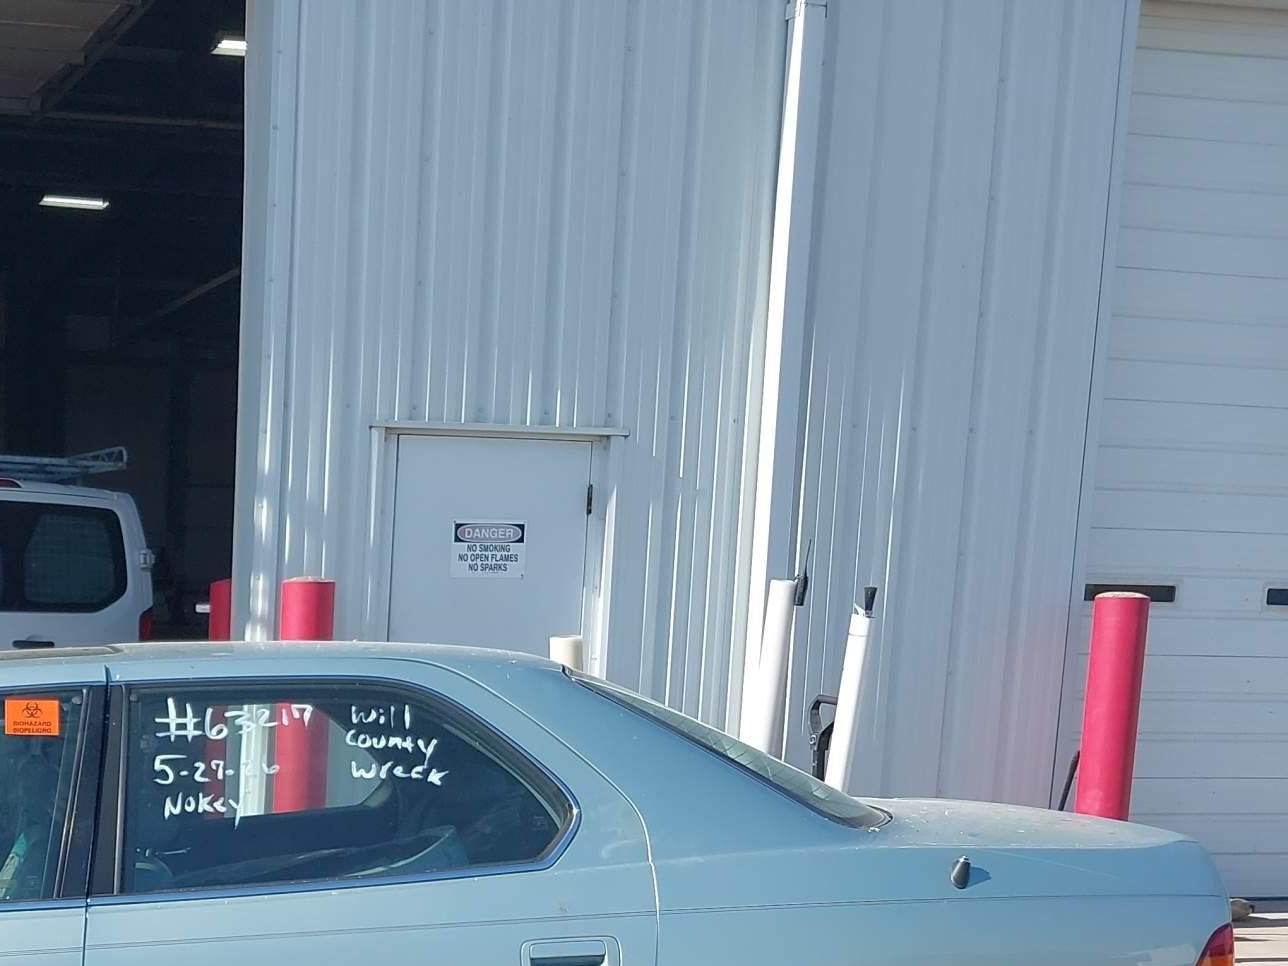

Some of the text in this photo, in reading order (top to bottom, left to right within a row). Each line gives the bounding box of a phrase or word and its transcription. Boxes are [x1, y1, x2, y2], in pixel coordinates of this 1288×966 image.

[464, 527, 514, 539] DANGER
[466, 543, 511, 553] NO SMOKING
[458, 553, 519, 562] NO OPEN FLAMES
[468, 563, 508, 572] NO SPARKS
